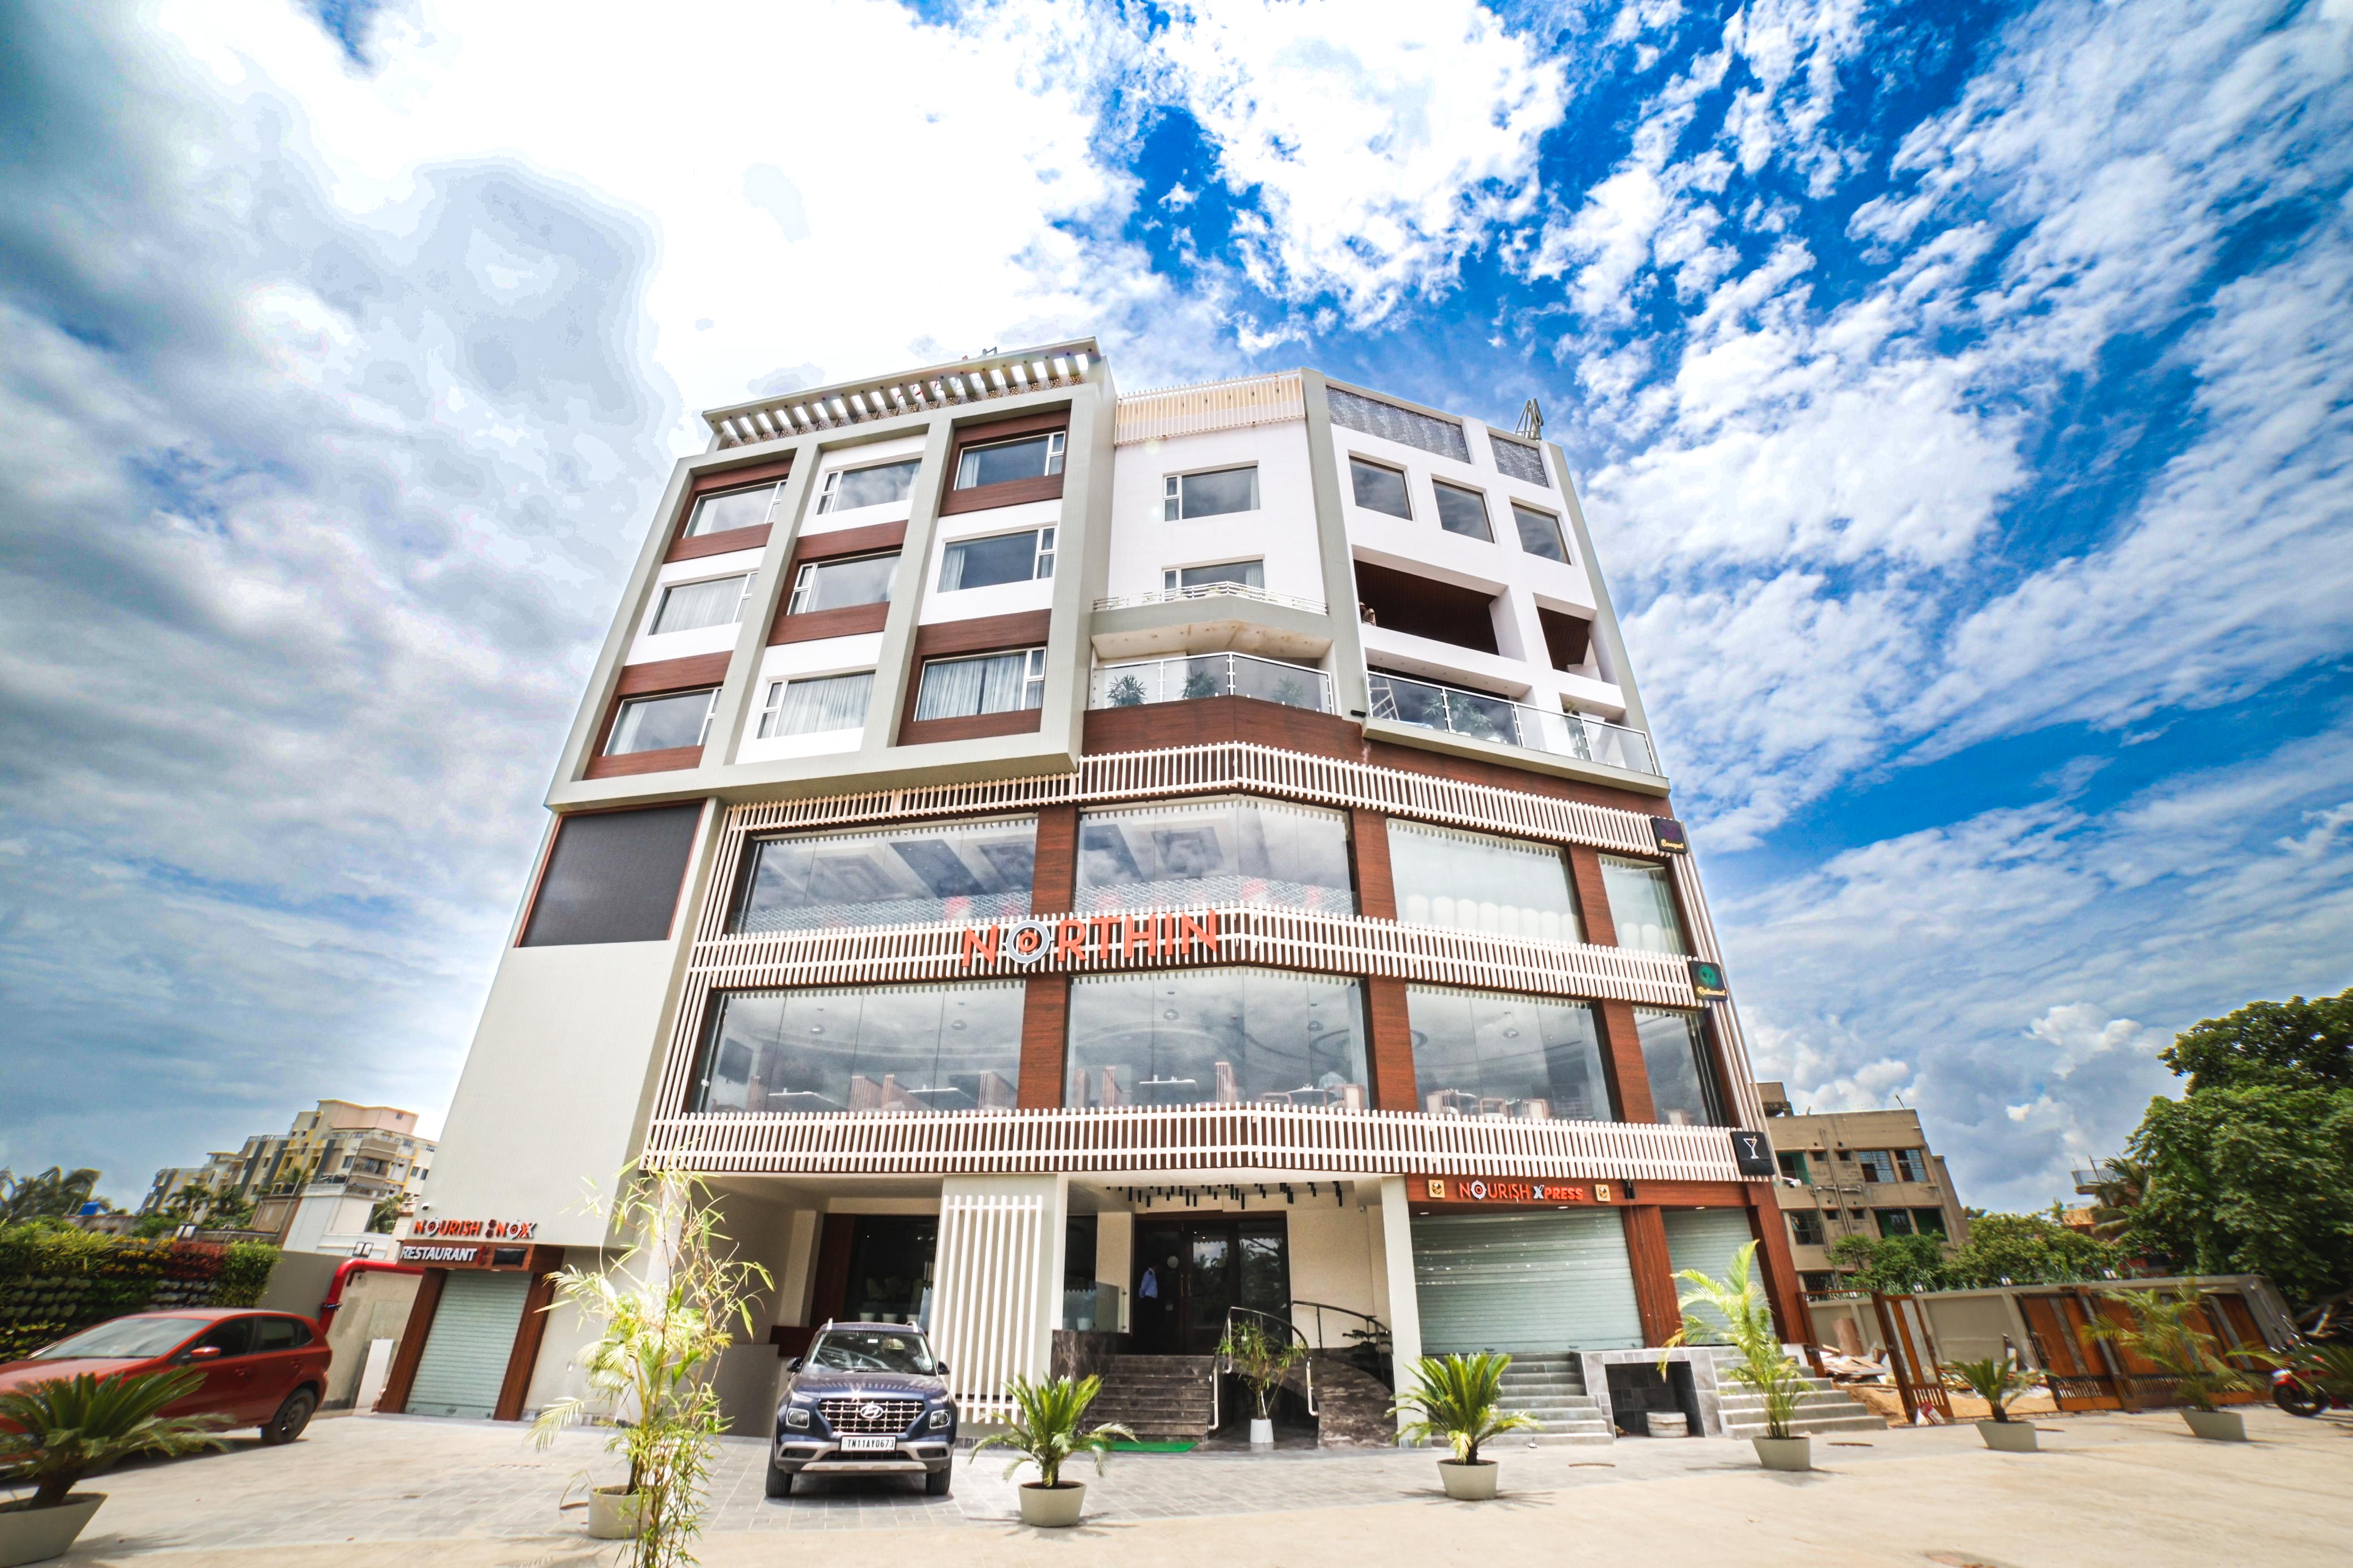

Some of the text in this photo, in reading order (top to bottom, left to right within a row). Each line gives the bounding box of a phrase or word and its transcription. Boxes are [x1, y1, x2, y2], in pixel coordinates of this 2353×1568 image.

[962, 910, 1217, 968] NORTHIN
[1459, 1180, 1584, 1200] NOURISH XPRESS
[413, 1217, 481, 1237] NOURISH
[400, 1246, 477, 1261] RESTAURANT
